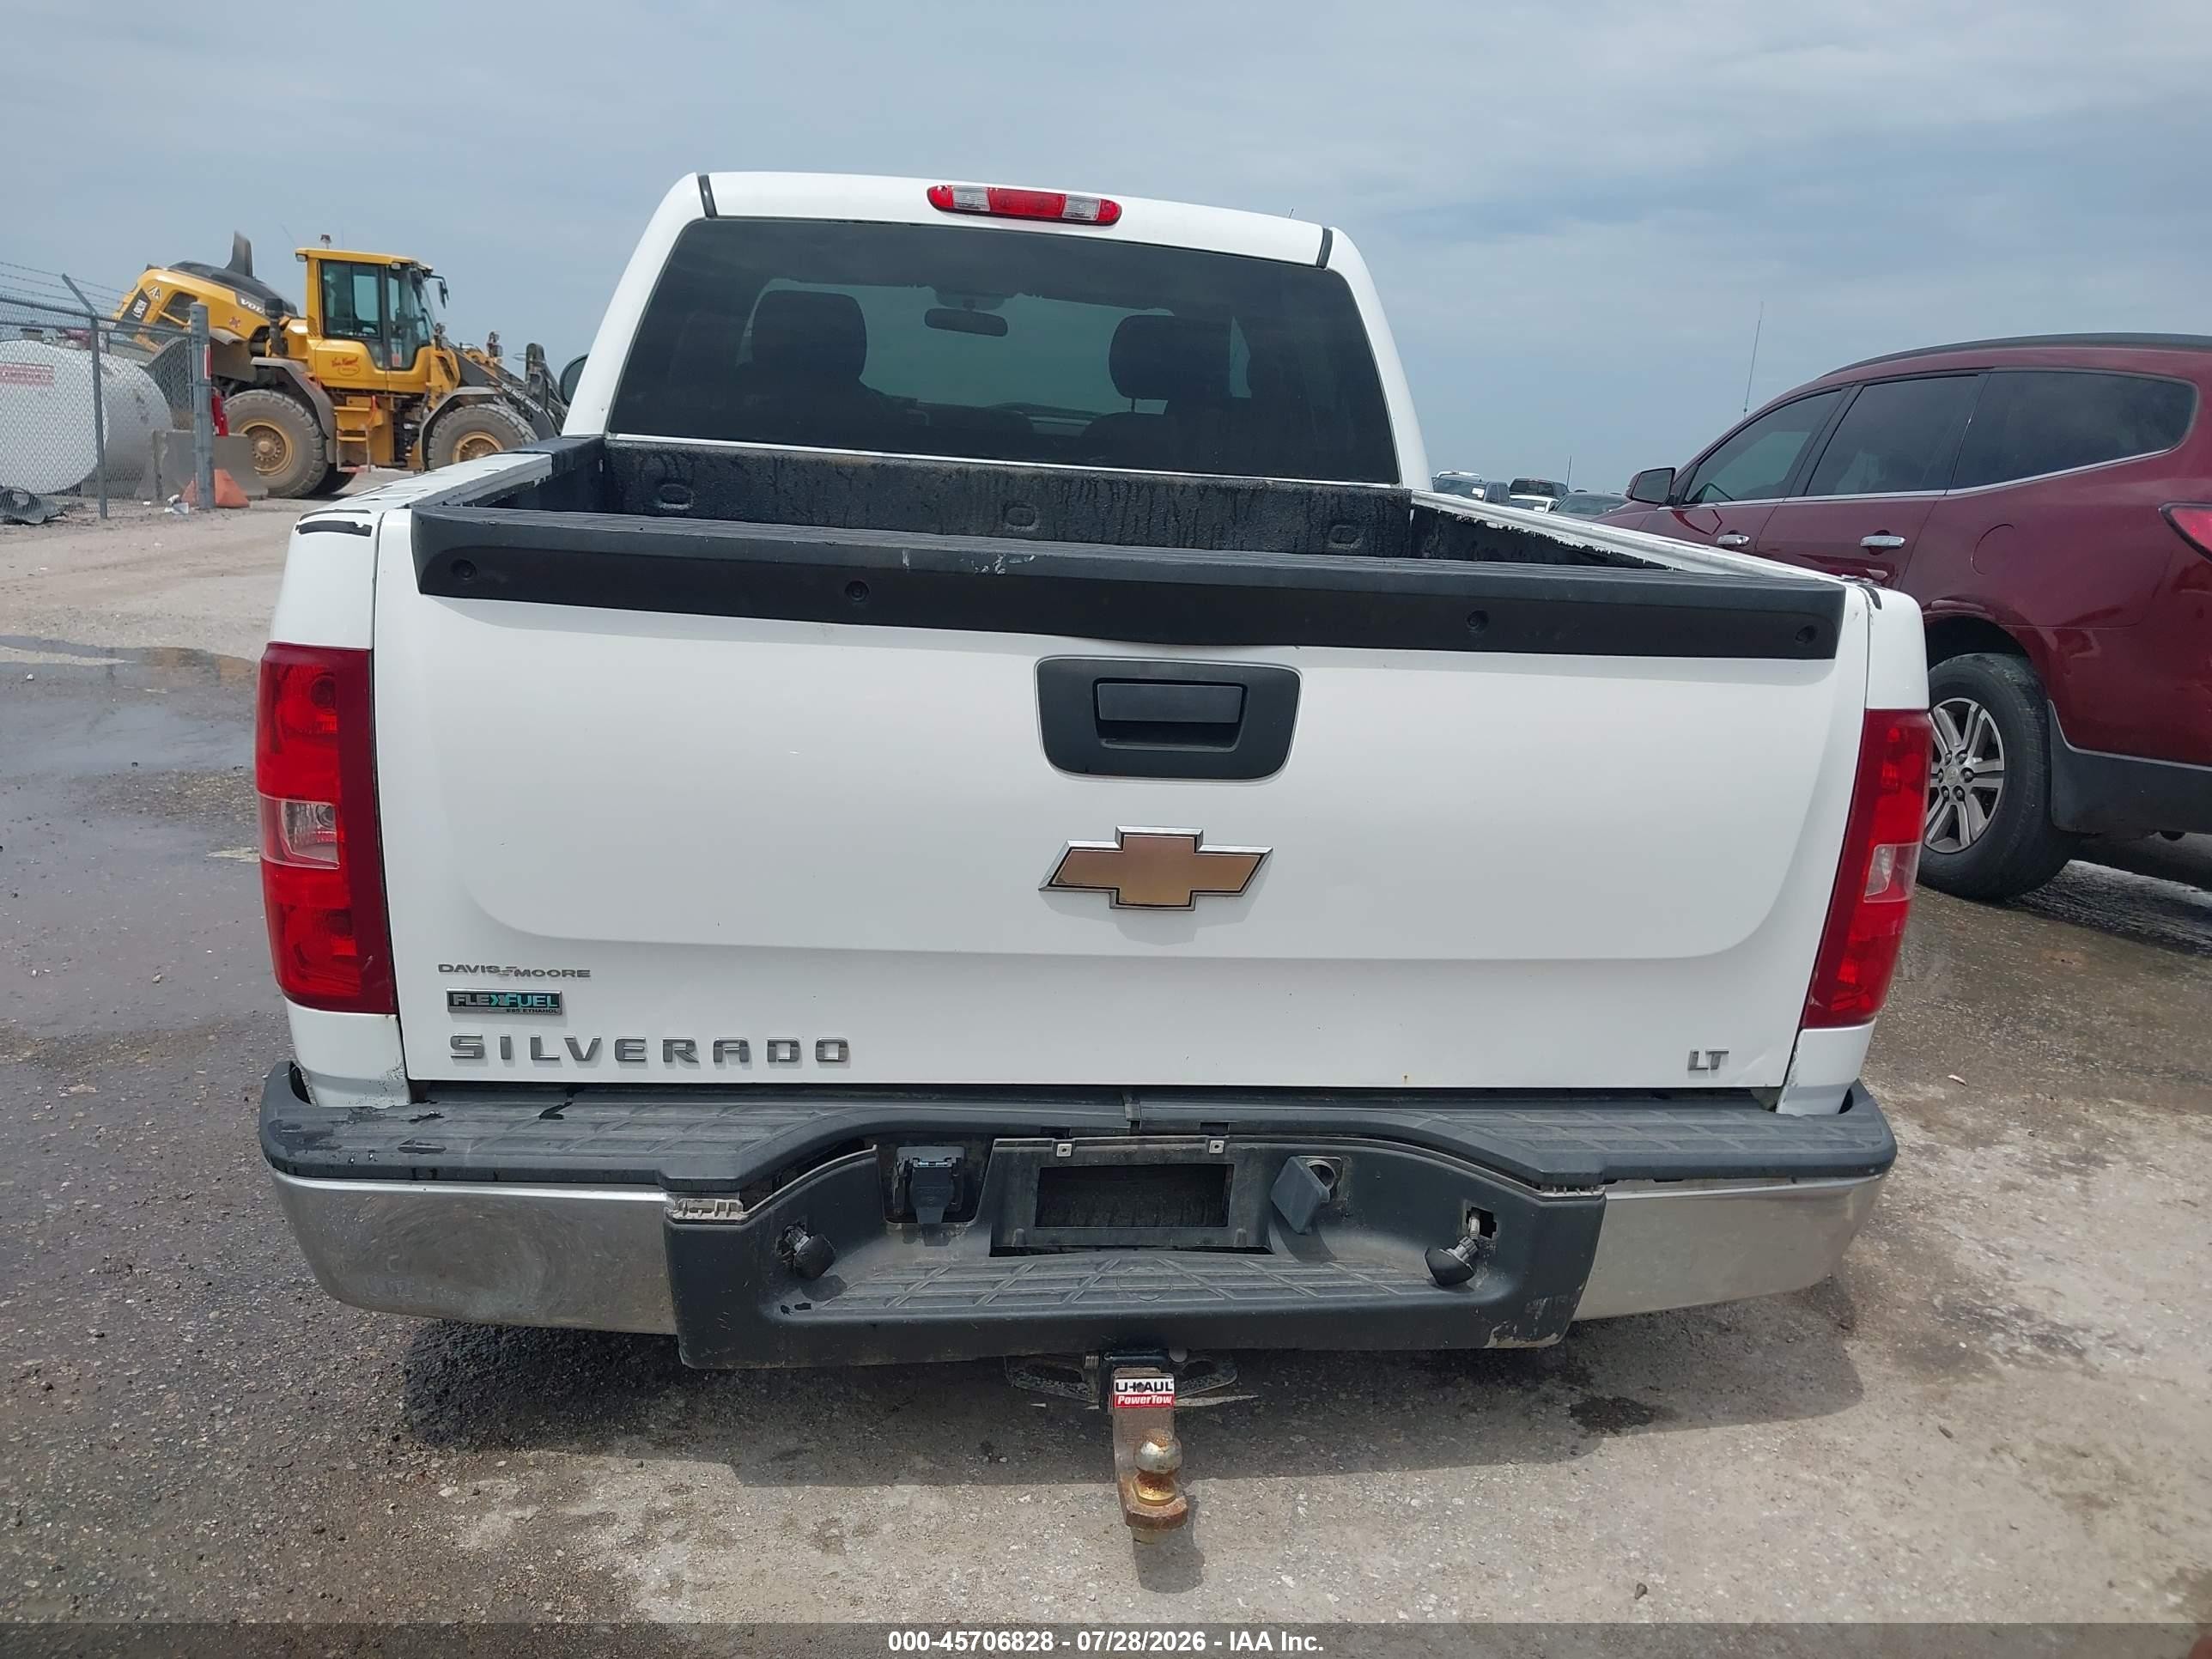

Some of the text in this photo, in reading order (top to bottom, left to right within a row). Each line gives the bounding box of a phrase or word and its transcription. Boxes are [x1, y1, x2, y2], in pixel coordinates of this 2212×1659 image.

[438, 963, 591, 978] DAVIS MOORE
[450, 1033, 849, 1063] SILVERADO
[1687, 1049, 1729, 1071] LT
[1117, 1395, 1173, 1405] PowerTow
